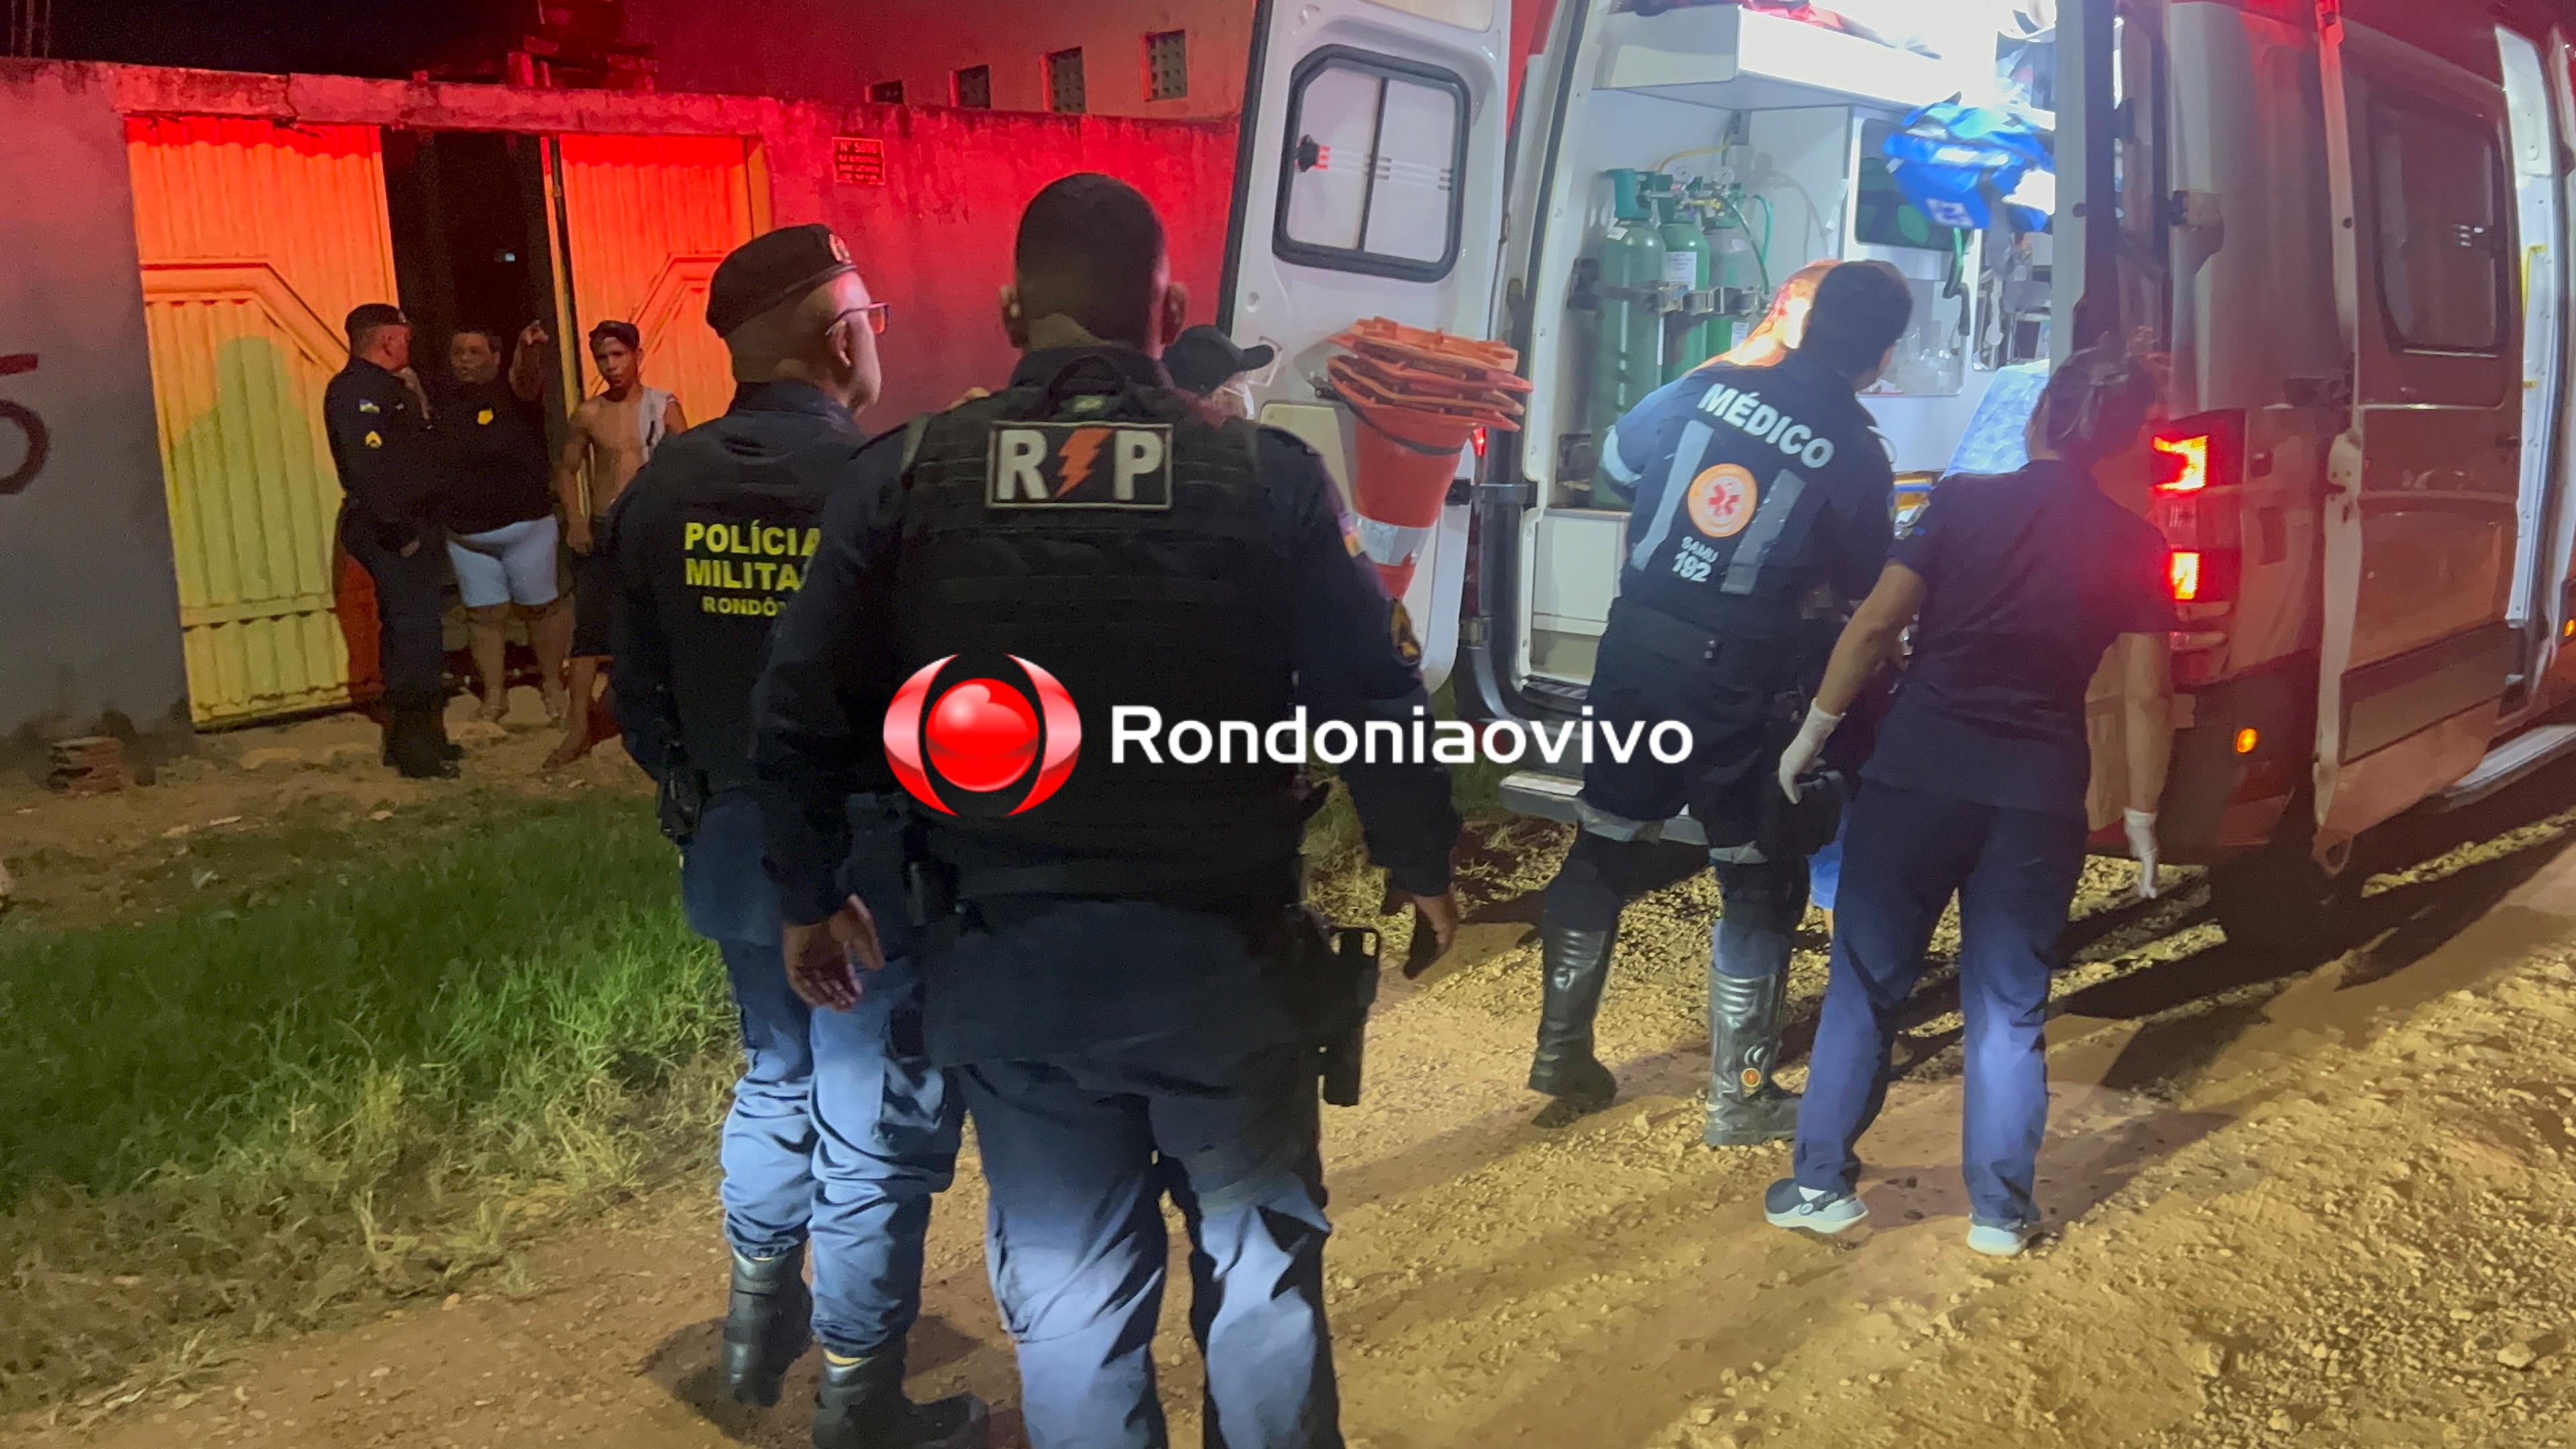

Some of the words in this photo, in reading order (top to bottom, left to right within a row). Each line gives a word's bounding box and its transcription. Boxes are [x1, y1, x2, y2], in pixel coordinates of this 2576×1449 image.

[1697, 383, 1835, 468] MÉDICO
[684, 519, 821, 556] POLÍCIA
[1681, 536, 1719, 563] SAMU
[684, 557, 802, 592] MILITA
[1672, 551, 1711, 582] 192
[702, 596, 788, 617] RONDÔ
